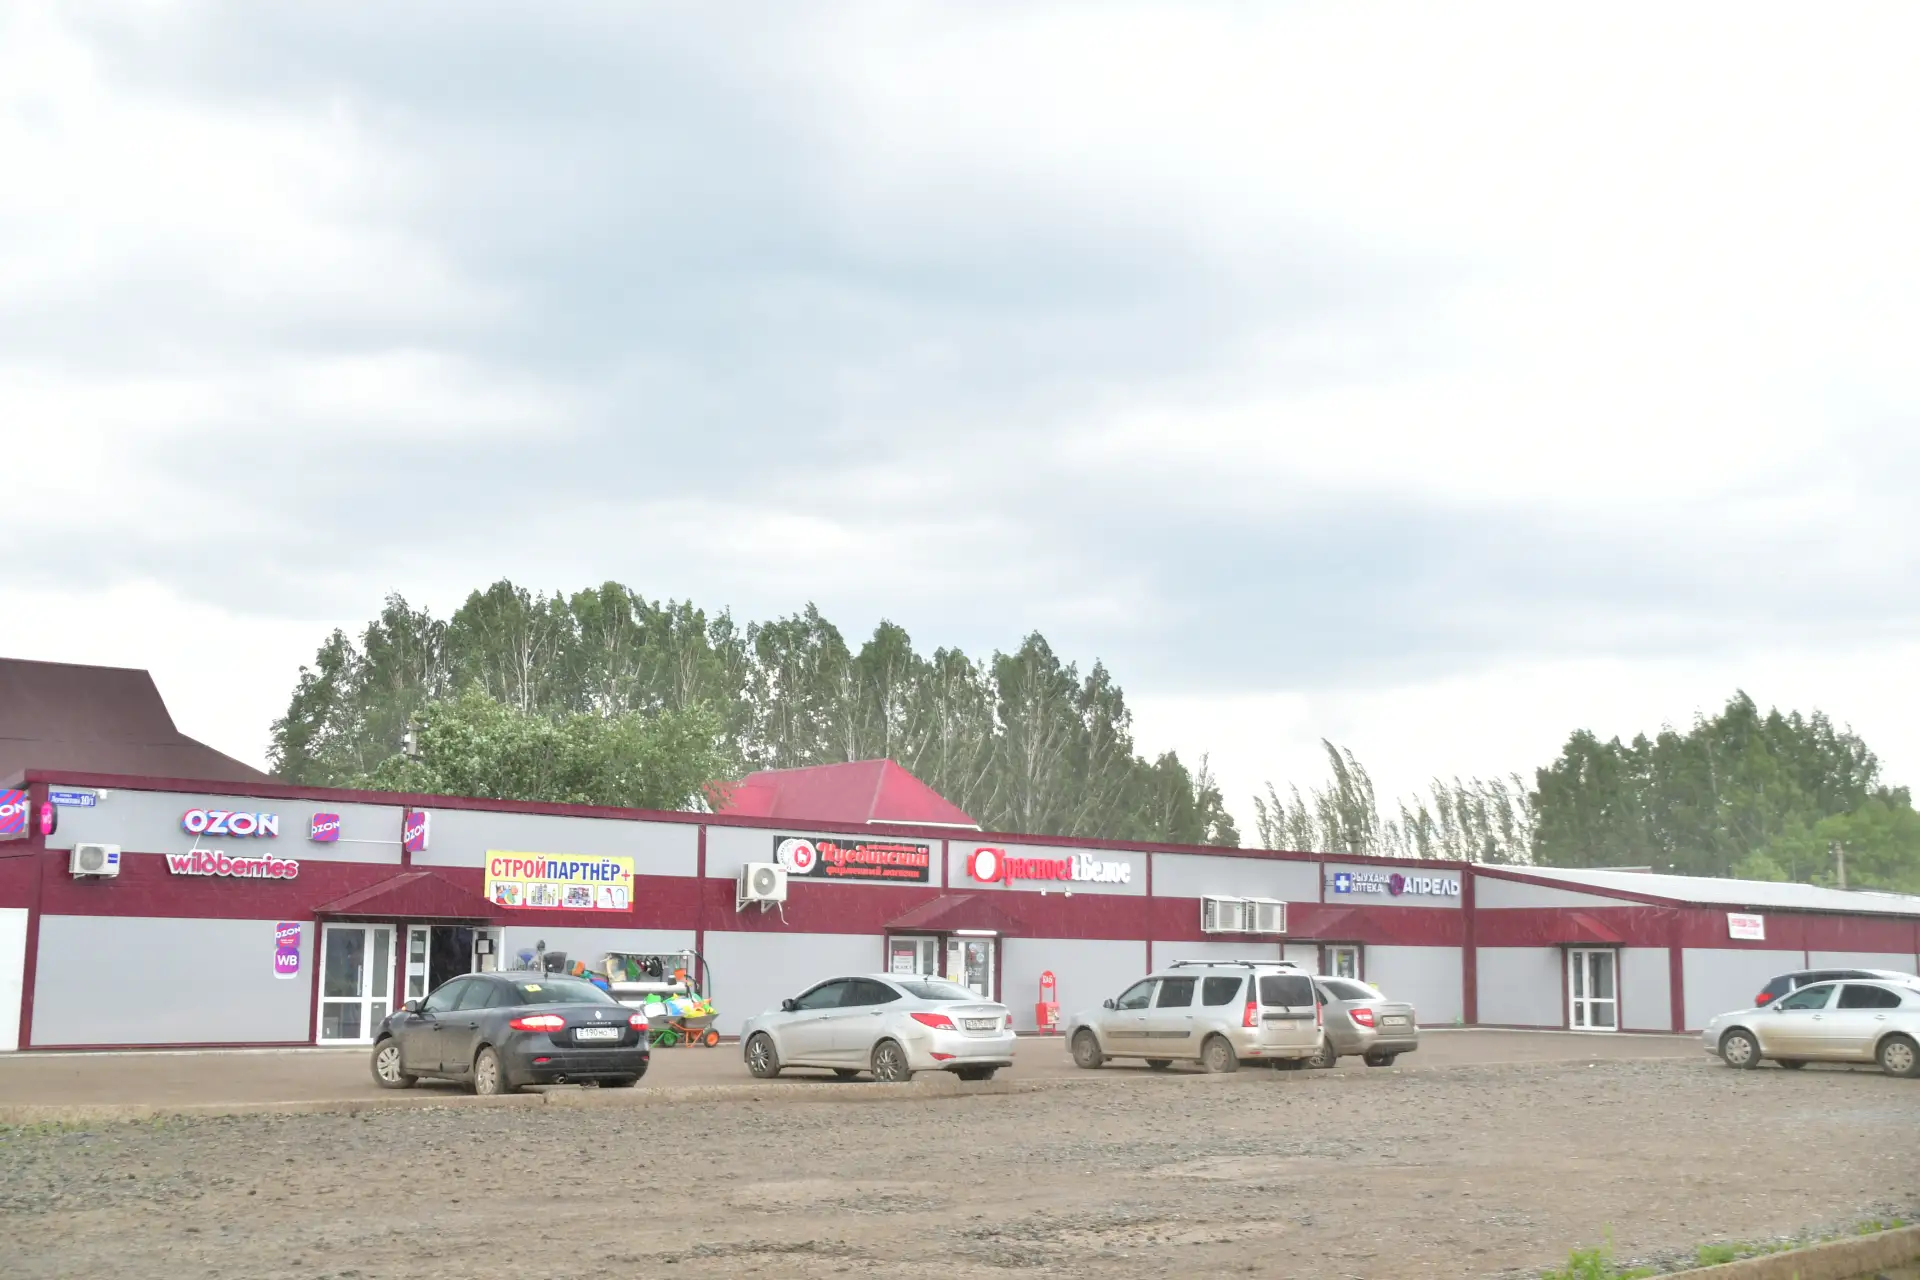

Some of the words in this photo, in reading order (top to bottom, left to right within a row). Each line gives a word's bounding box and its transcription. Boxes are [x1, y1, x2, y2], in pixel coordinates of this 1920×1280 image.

[0, 802, 25, 816] ON
[181, 808, 279, 838] OZON
[312, 820, 340, 833] OZON
[404, 823, 425, 843] OZON
[165, 848, 299, 879] wildberries
[1352, 872, 1390, 884] РЫУХАНА
[1352, 882, 1384, 892] АПТЕКА
[1402, 877, 1460, 896] АПРЕЛЬ
[275, 926, 301, 938] OZON
[277, 954, 298, 966] WB
